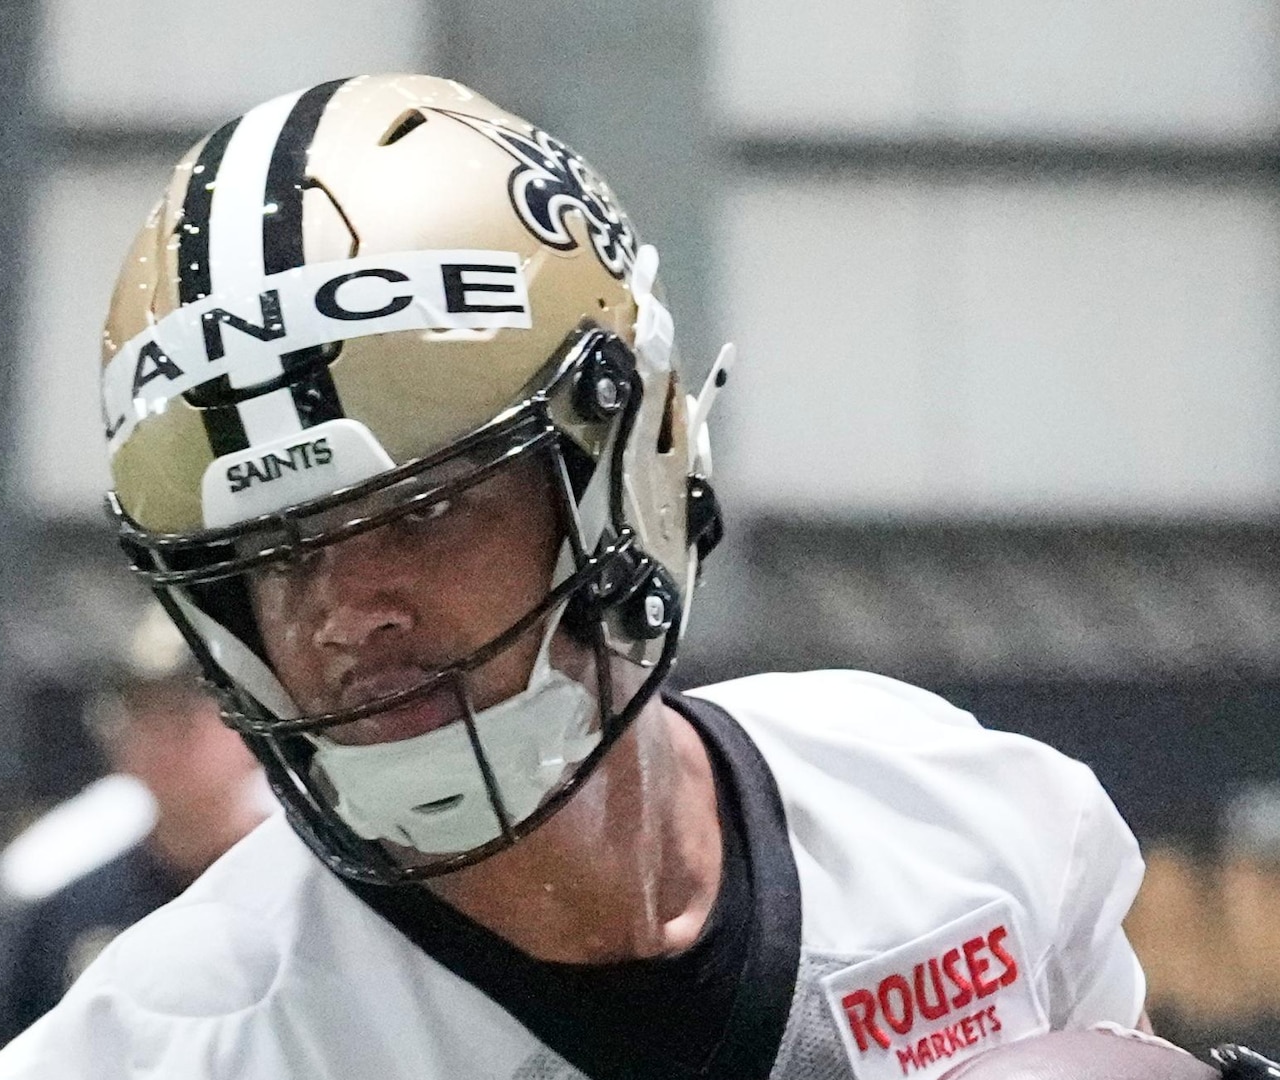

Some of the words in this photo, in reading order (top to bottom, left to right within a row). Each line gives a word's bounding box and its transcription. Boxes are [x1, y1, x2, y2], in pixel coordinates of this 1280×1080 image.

[227, 437, 333, 493] SAINTS
[841, 925, 1018, 1052] ROUSES
[896, 1004, 1003, 1076] MARKETS
